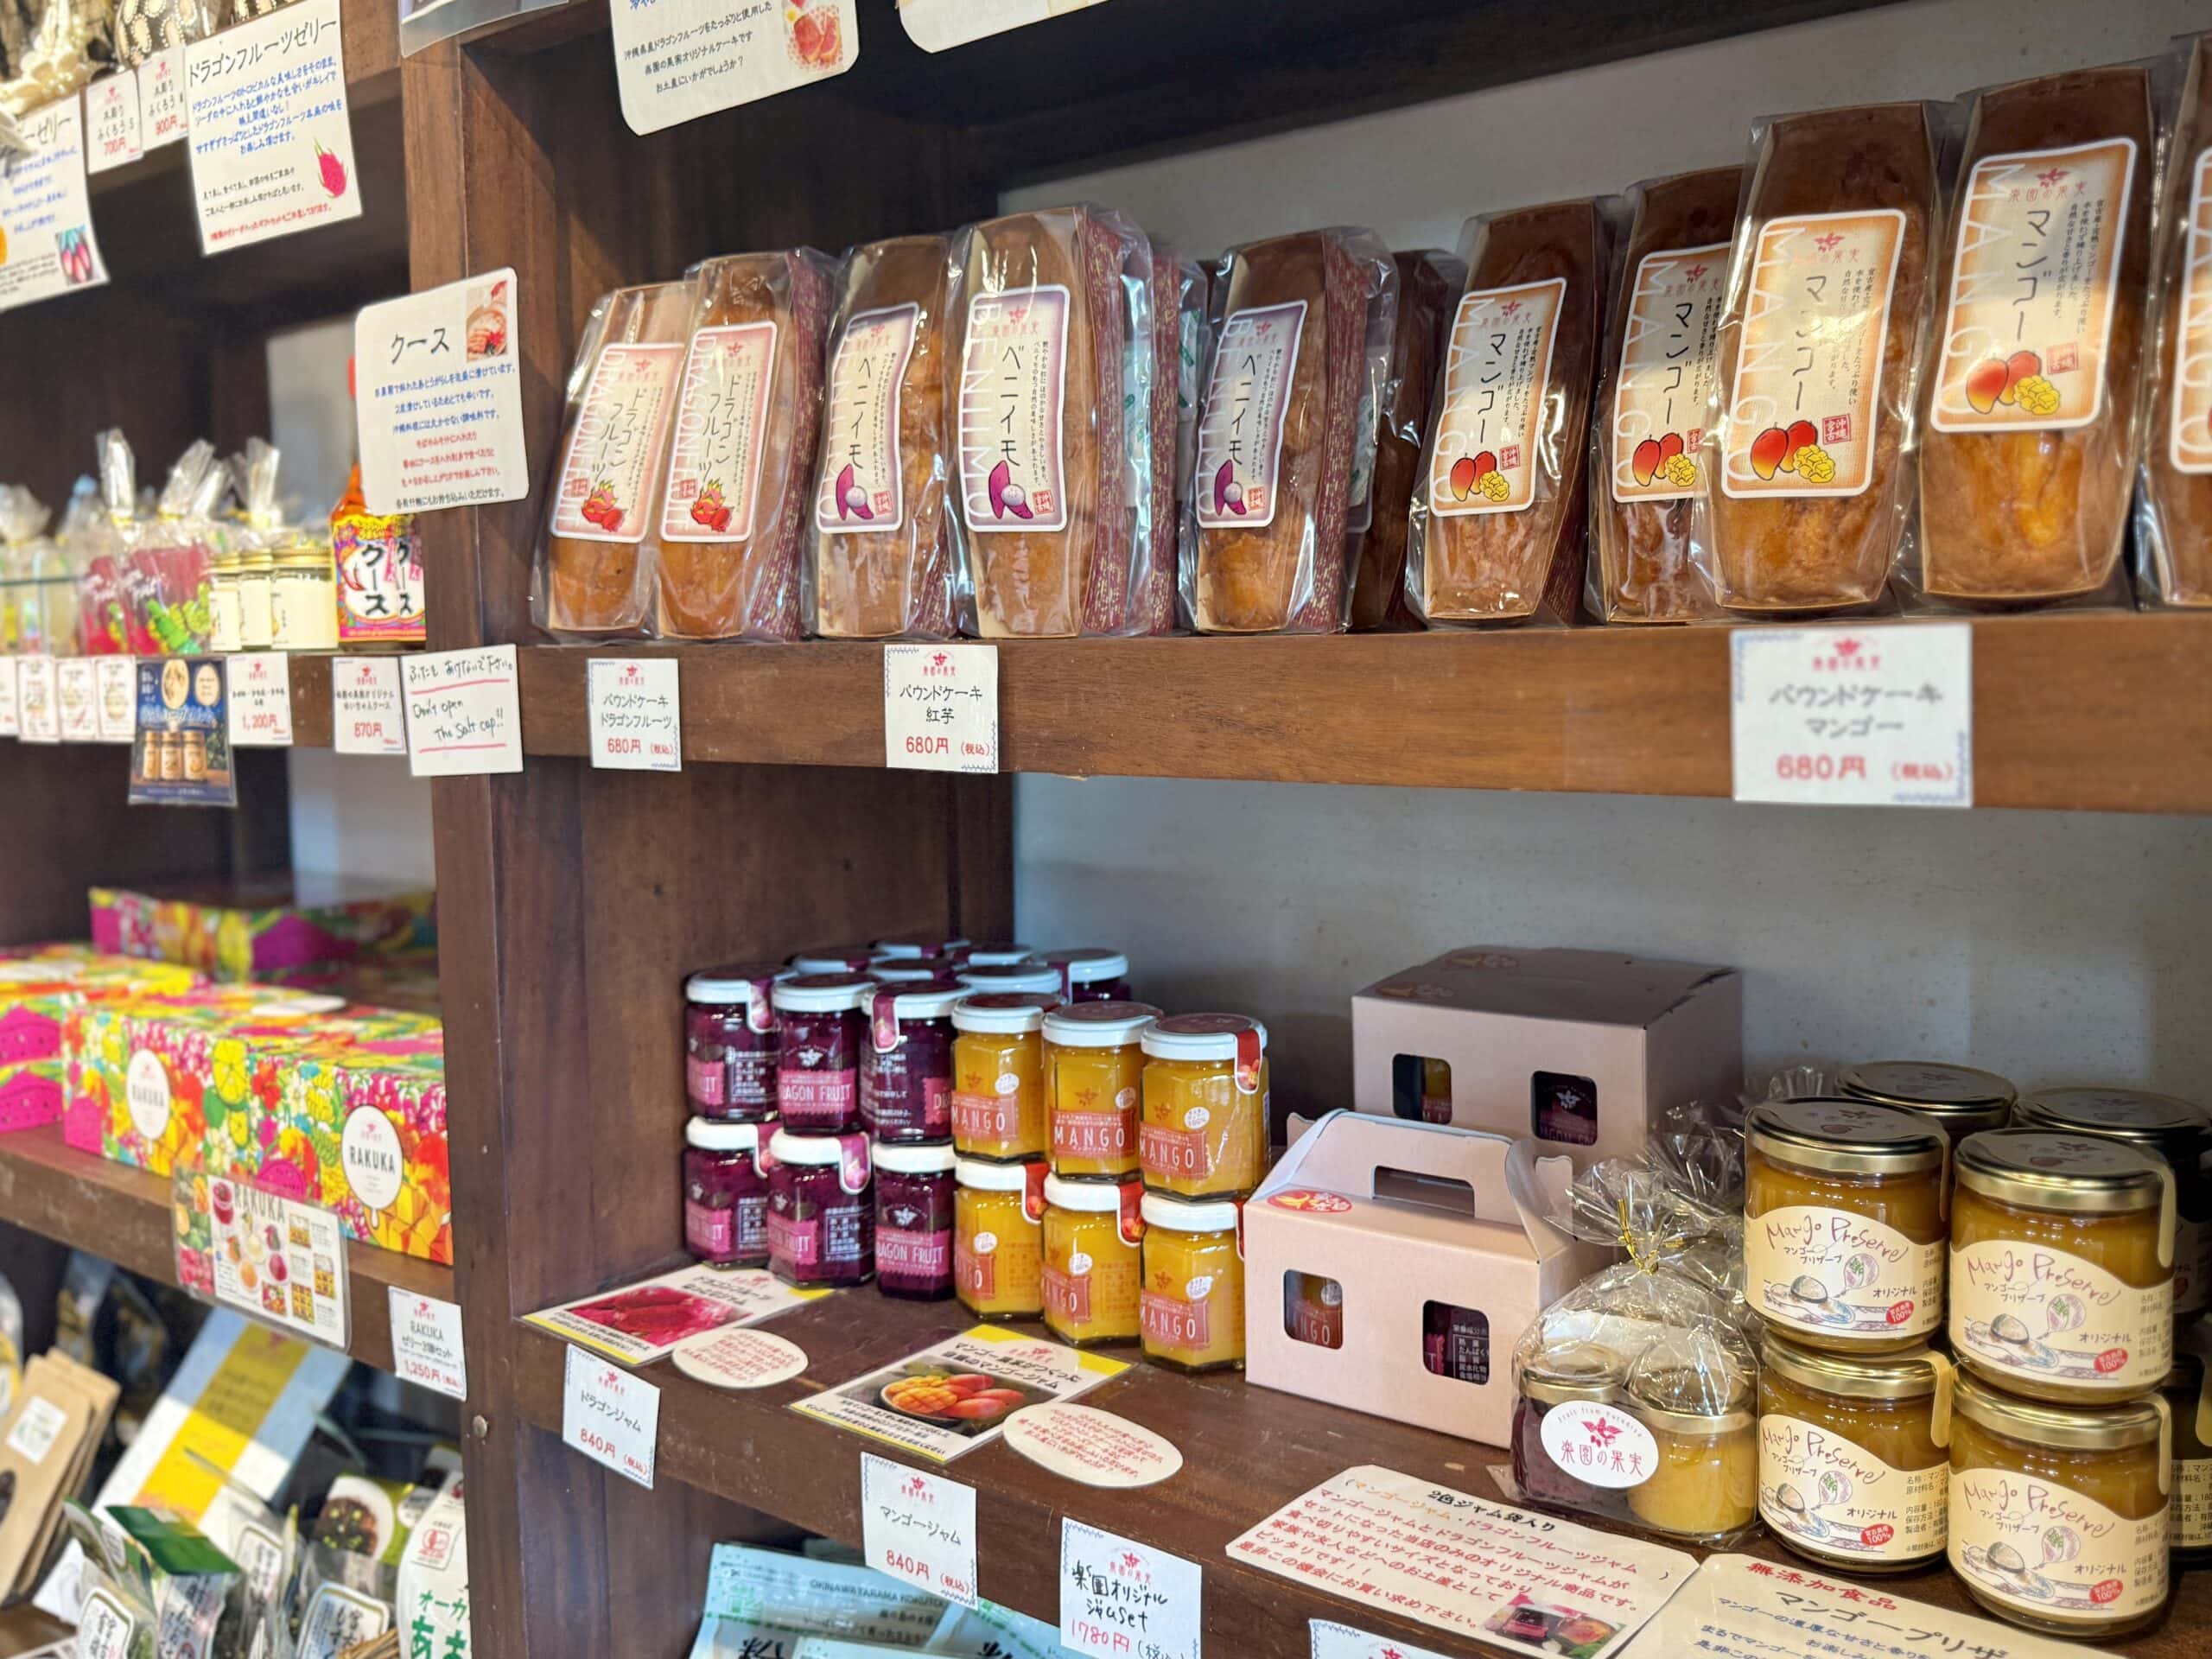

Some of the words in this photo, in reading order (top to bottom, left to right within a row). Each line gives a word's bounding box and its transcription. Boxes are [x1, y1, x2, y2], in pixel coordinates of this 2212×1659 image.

[190, 18, 336, 86] ドラゴンフルーツゼリー
[2012, 209, 2051, 341] マンゴー
[391, 327, 450, 365] クース
[1662, 302, 1693, 425] マンゴー
[1478, 333, 1507, 444] マンゴー
[716, 374, 742, 463] ドラゴン
[849, 355, 877, 469] ベニイモ
[1000, 345, 1025, 467] ベニイモ
[1229, 354, 1262, 465] ベニイモ
[592, 404, 624, 481] フルーツ
[611, 389, 647, 467] ドラゴン
[698, 393, 720, 481] フルーツ
[362, 544, 389, 615] クース
[442, 700, 463, 717] open
[604, 694, 669, 709] パウンドケーキ
[899, 684, 982, 701] パウンドケーキ
[1769, 683, 1943, 708] パウンドケーキ
[601, 713, 671, 729] ドラゴンフルーツ
[926, 707, 954, 724] 紅芋
[1805, 715, 1904, 739] マンゴー
[607, 738, 641, 753] 680円
[906, 736, 949, 753] 680円
[1776, 754, 1866, 780] 680円
[820, 1084, 851, 1102] FRUIT
[1053, 1124, 1125, 1148] MANGO
[350, 1147, 395, 1173] RAKUKA
[233, 1182, 284, 1224] RAKUKA
[1766, 1216, 1821, 1249] Mango
[912, 1246, 944, 1264] FRUIT
[1967, 1250, 2024, 1286] Mango
[1873, 1287, 1917, 1298] オリジナル
[410, 1320, 443, 1341] RAKUKA
[2079, 1333, 2130, 1343] オリジナル
[581, 1389, 642, 1433] ドラゴンジャム
[580, 1428, 615, 1459] 840円
[1761, 1425, 1799, 1455] Mango
[1561, 1440, 1643, 1478] 楽園の果実
[1963, 1479, 2018, 1511] Mango
[880, 1505, 961, 1545] マンゴージャム
[1847, 1509, 1898, 1519] オリジナル
[887, 1549, 930, 1581] 840円
[2075, 1564, 2126, 1575] オリジナル
[1746, 1561, 1897, 1611] 無添加食品
[1071, 1618, 1130, 1653] 1780円
